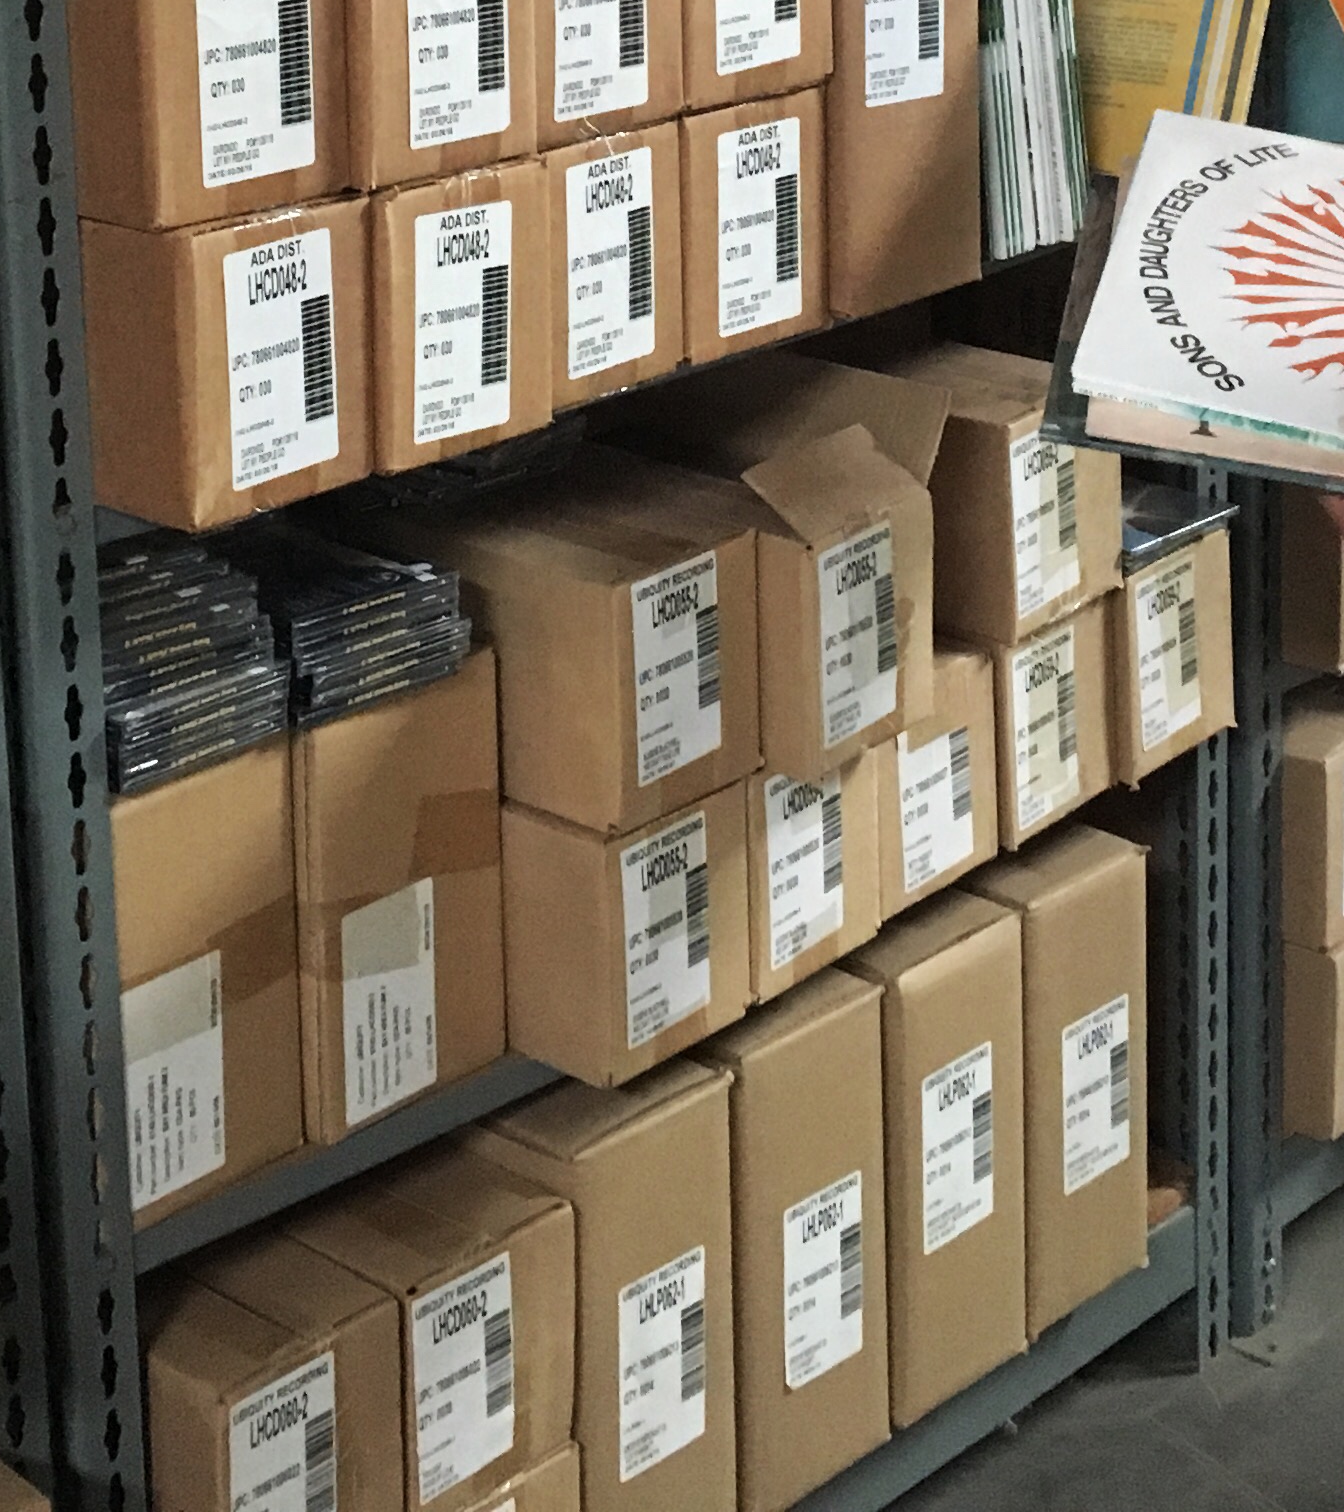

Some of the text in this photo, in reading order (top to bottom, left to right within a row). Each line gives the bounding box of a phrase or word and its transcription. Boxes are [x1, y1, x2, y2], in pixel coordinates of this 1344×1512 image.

[738, 132, 757, 146] ADA
[588, 156, 631, 179] ADA DIST.
[736, 142, 781, 179] LHCD048-2
[585, 174, 633, 213] LHCD048-2
[440, 210, 489, 230] ADA DIST.
[251, 239, 306, 268] ADA DIST.
[437, 229, 490, 267] LHCD048-2
[1139, 142, 1299, 392] SONS AND DAUGHTERS OF LITE
[248, 259, 307, 306] LHCD048-2
[802, 1200, 843, 1243] LHLP062-1
[658, 1250, 701, 1282] RECORDING
[415, 1261, 505, 1320] UBIQUITY RECORDING
[639, 1275, 685, 1324] LHLP062-1
[432, 1290, 487, 1345] LHCD060-2
[233, 1361, 329, 1426] UBIQUITY RECORDING
[249, 1391, 308, 1449] LHCD060-2
